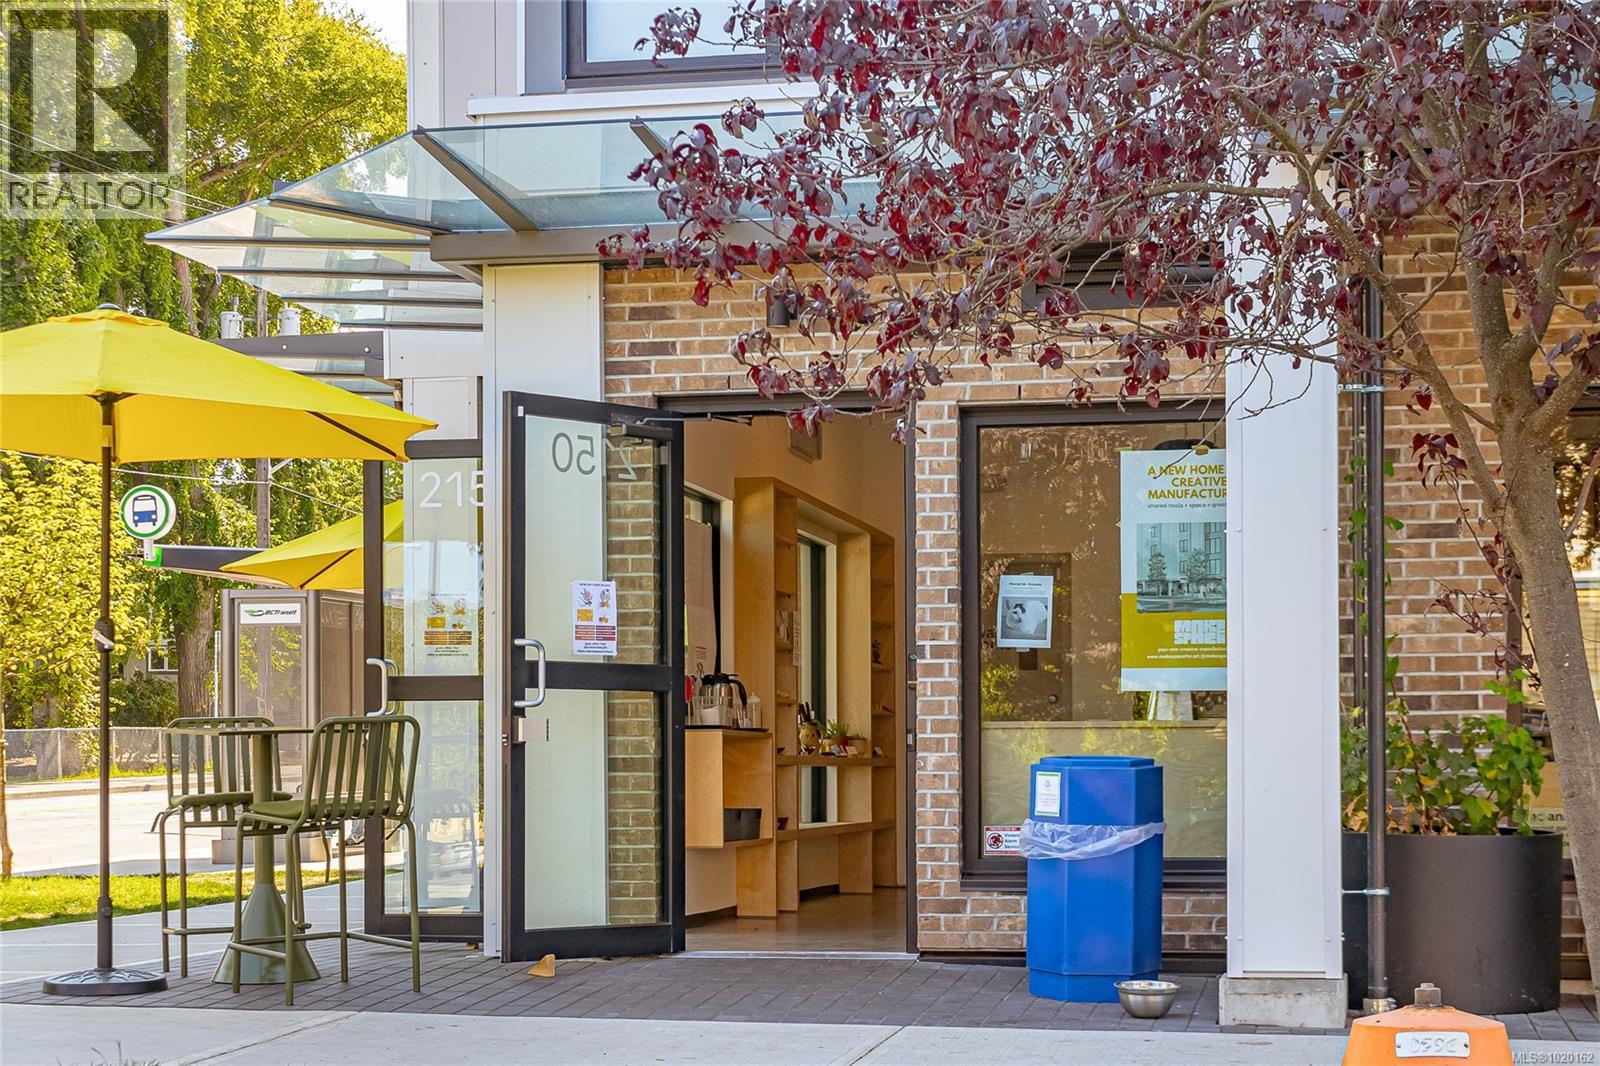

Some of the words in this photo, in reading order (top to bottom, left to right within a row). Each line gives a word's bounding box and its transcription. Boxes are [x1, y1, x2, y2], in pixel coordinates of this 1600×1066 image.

[1147, 466, 1157, 476] A
[1160, 465, 1187, 475] NEW
[1190, 464, 1225, 475] HOME
[1171, 476, 1227, 487] CREATIVE
